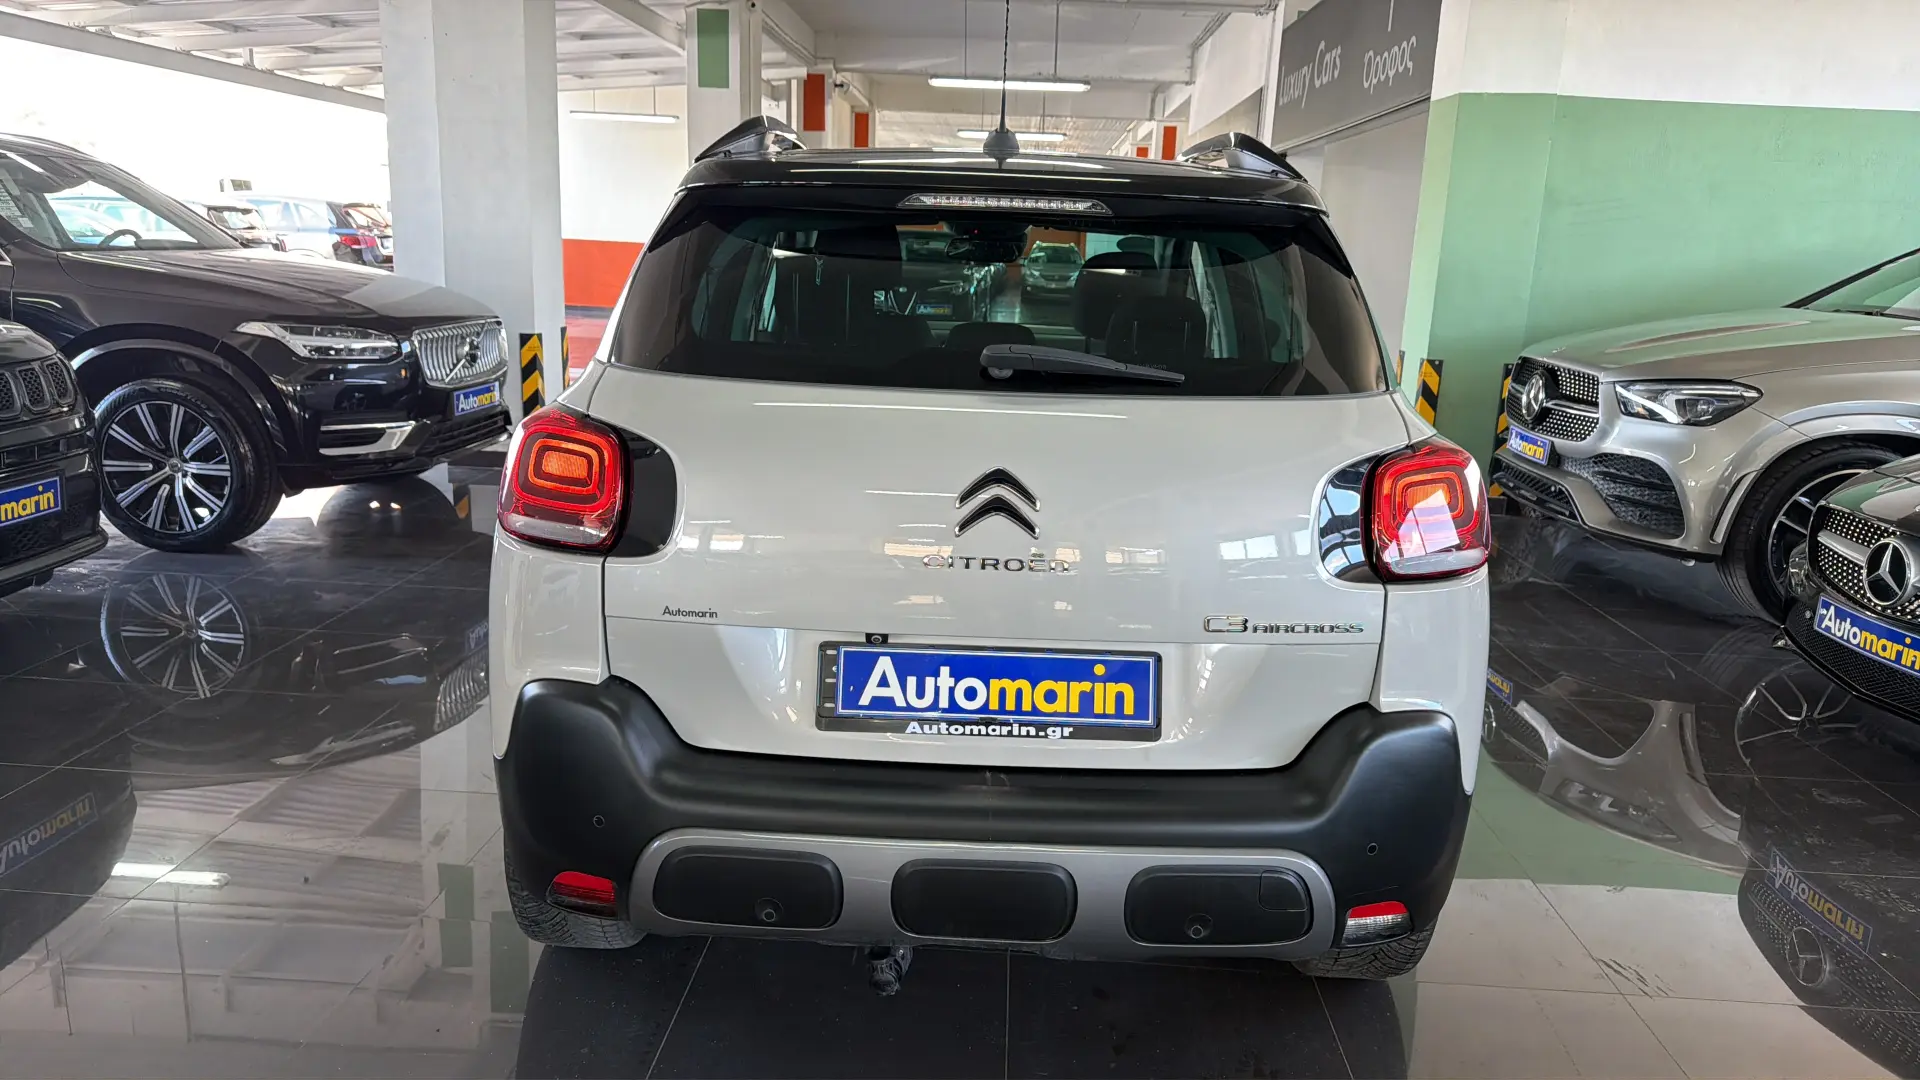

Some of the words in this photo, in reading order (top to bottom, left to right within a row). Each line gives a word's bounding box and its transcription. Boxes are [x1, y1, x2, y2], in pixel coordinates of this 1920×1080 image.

[1279, 62, 1313, 109] Luxury
[1314, 40, 1342, 89] Cars
[662, 605, 718, 618] Automarin
[1204, 615, 1249, 633] C3
[1252, 622, 1365, 634] AIRCROSS
[1820, 604, 1920, 671] Automarin
[857, 655, 1136, 716] Automarin
[905, 721, 1074, 739] Automarin.gr
